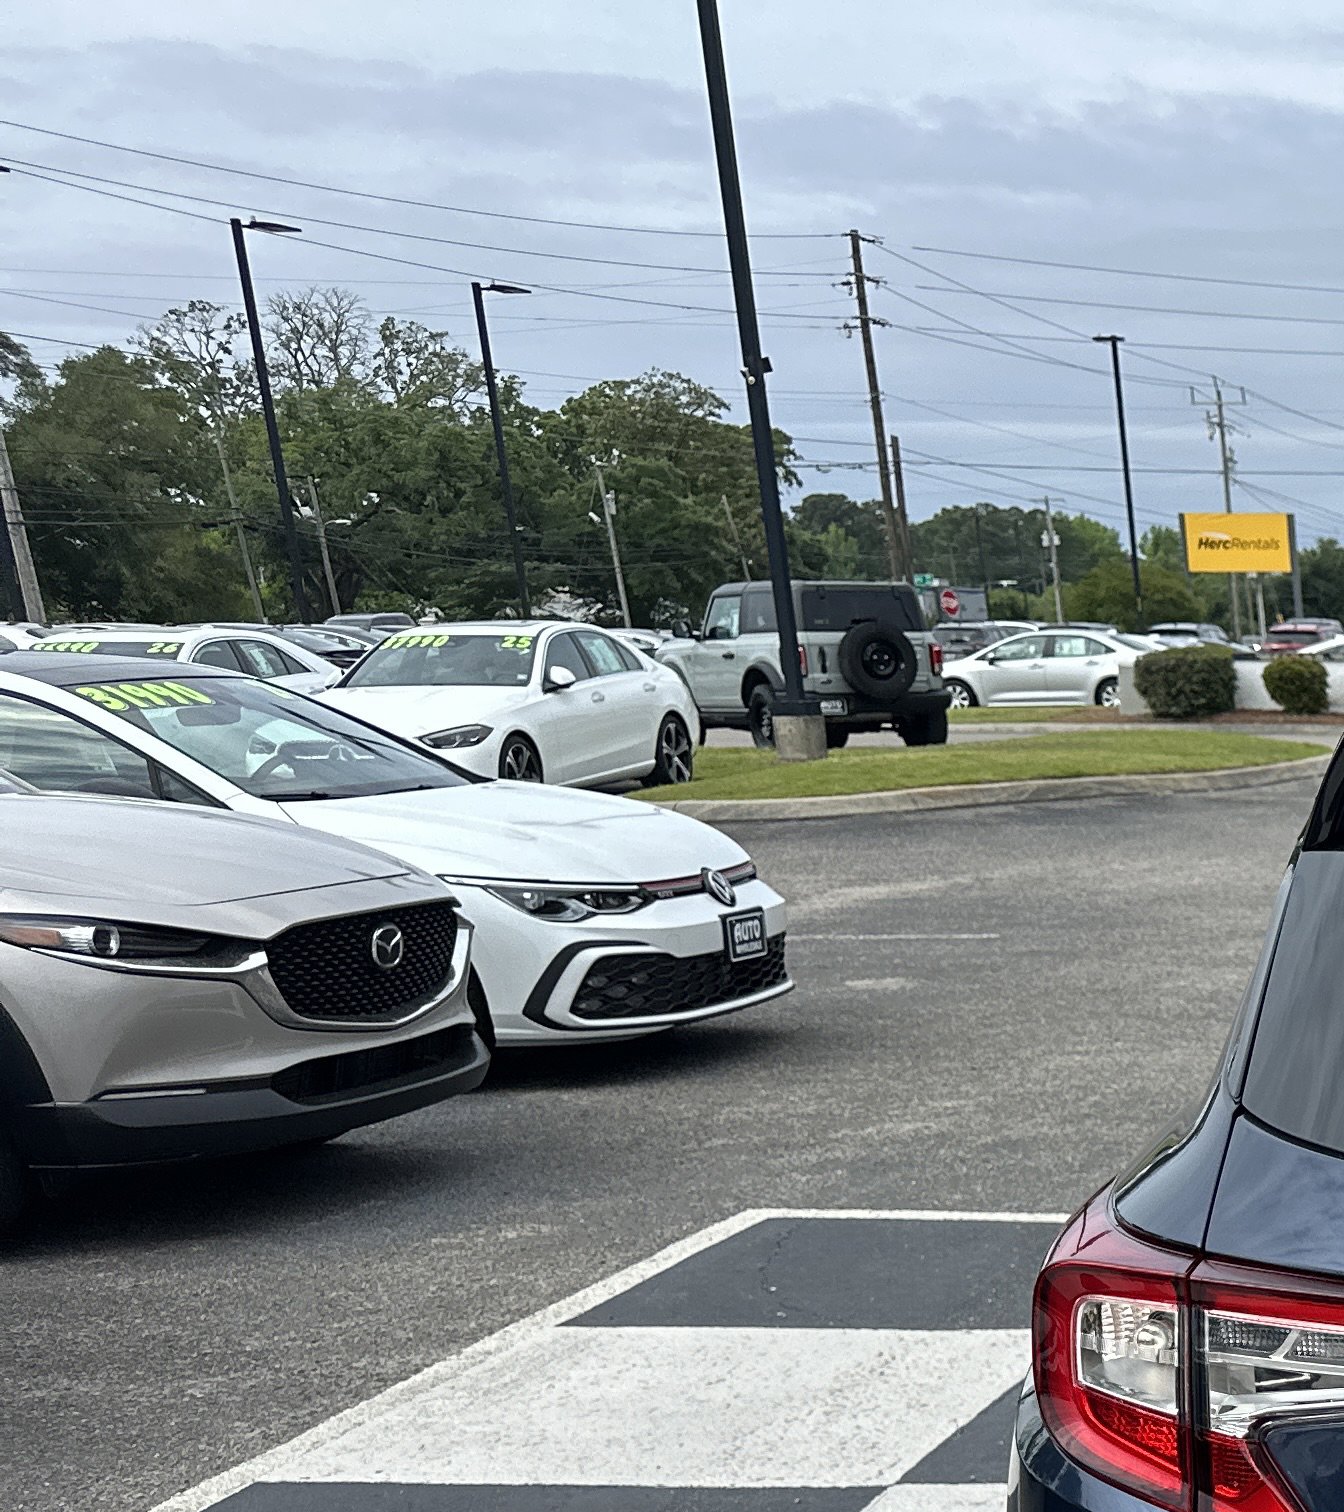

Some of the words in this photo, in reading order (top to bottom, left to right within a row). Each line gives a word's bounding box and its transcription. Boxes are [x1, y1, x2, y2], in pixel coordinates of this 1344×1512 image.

[146, 642, 180, 654] 26
[501, 635, 533, 648] 25
[75, 681, 216, 711] 31990
[734, 919, 761, 944] AUTO
